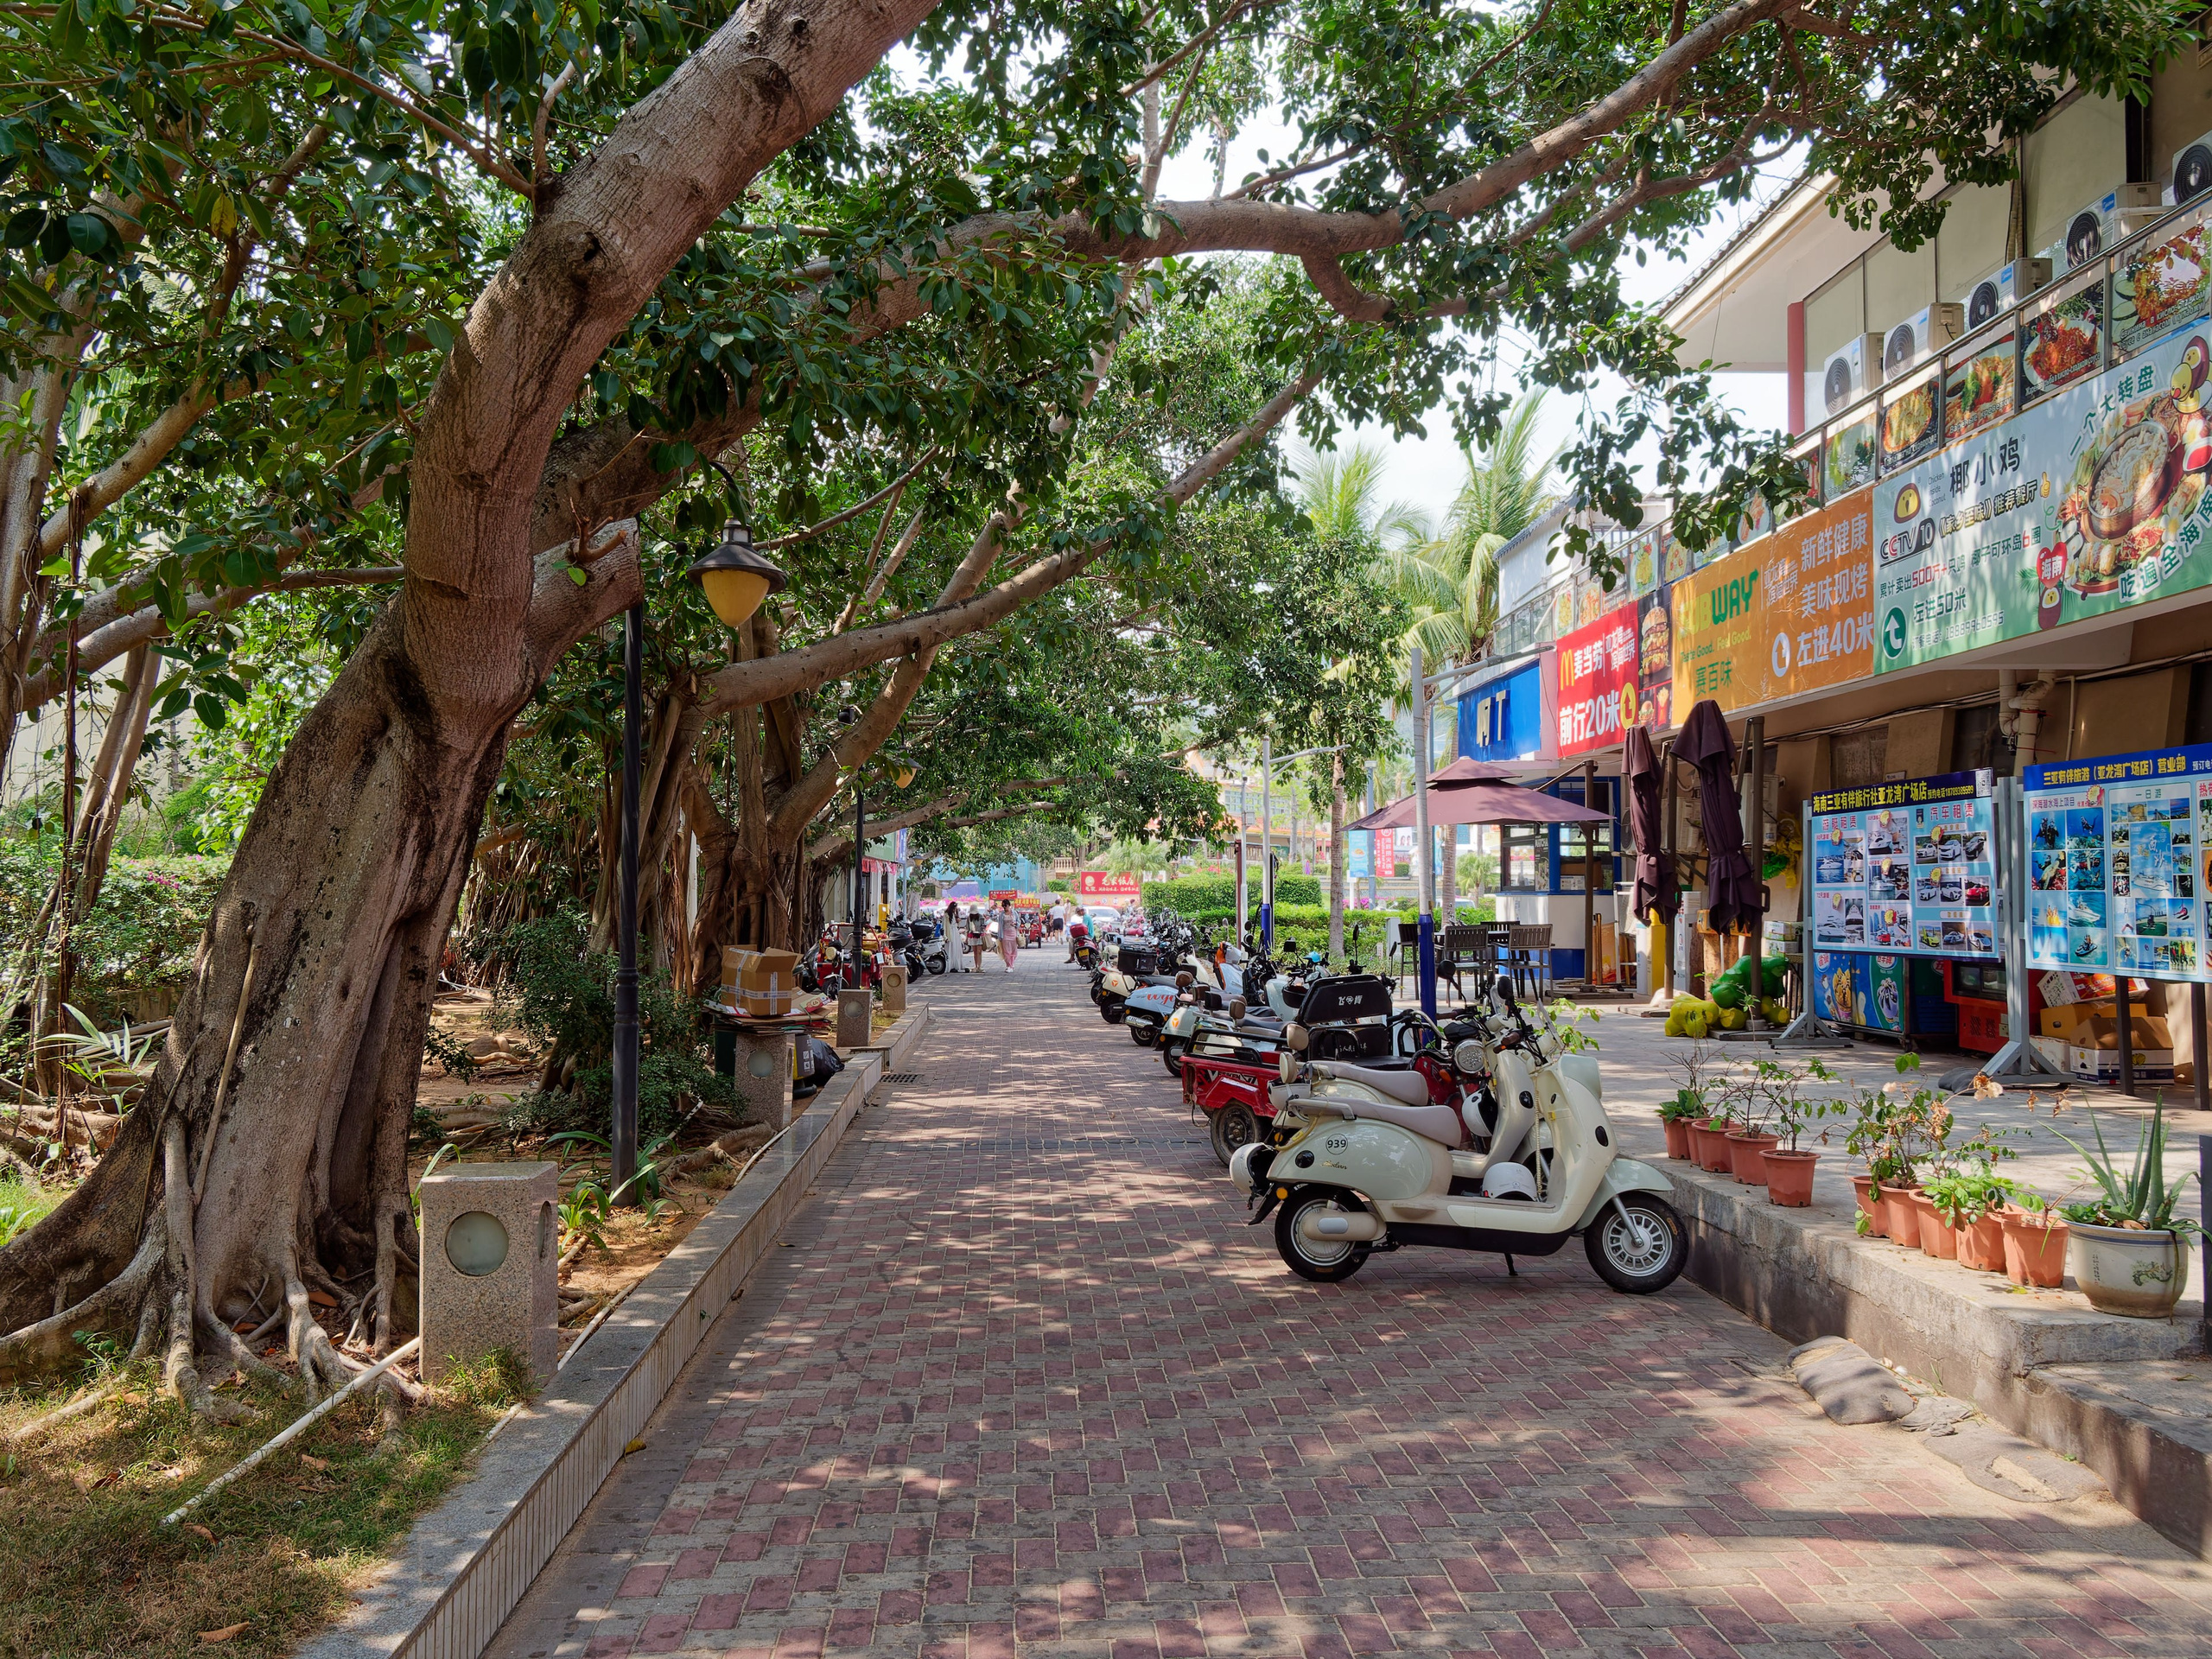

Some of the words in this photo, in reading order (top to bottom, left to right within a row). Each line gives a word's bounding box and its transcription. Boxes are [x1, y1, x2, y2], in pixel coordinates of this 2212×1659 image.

[2069, 365, 2154, 456] 一个大转盘
[1928, 472, 1944, 486] Chicken
[1949, 437, 2020, 499] 椰小鸡
[1801, 512, 1868, 573] 新鲜健康
[1880, 523, 1916, 560] CCTV
[1920, 522, 1932, 546] 10
[2041, 555, 2063, 580] 海南
[1677, 569, 1759, 641] SUBWAY
[1802, 563, 1868, 619] 美味现烤
[1913, 587, 1967, 624] 左进50米
[1716, 633, 1731, 651] Feel
[1732, 626, 1751, 645] Good.
[1796, 611, 1874, 667] 左进40米
[1573, 639, 1604, 680] 麦当劳
[1695, 658, 1732, 696] 赛百味
[1559, 689, 1620, 747] 前行20米
[2192, 759, 2212, 772] 预订电
[1813, 780, 1928, 813] 海南三亚有伴旅行社亚龙湾广场店
[1930, 803, 1974, 821] 汽车租赁
[2135, 788, 2162, 799] 一日游
[1327, 1140, 1346, 1148] 939
[1320, 1160, 1347, 1170] Modern
